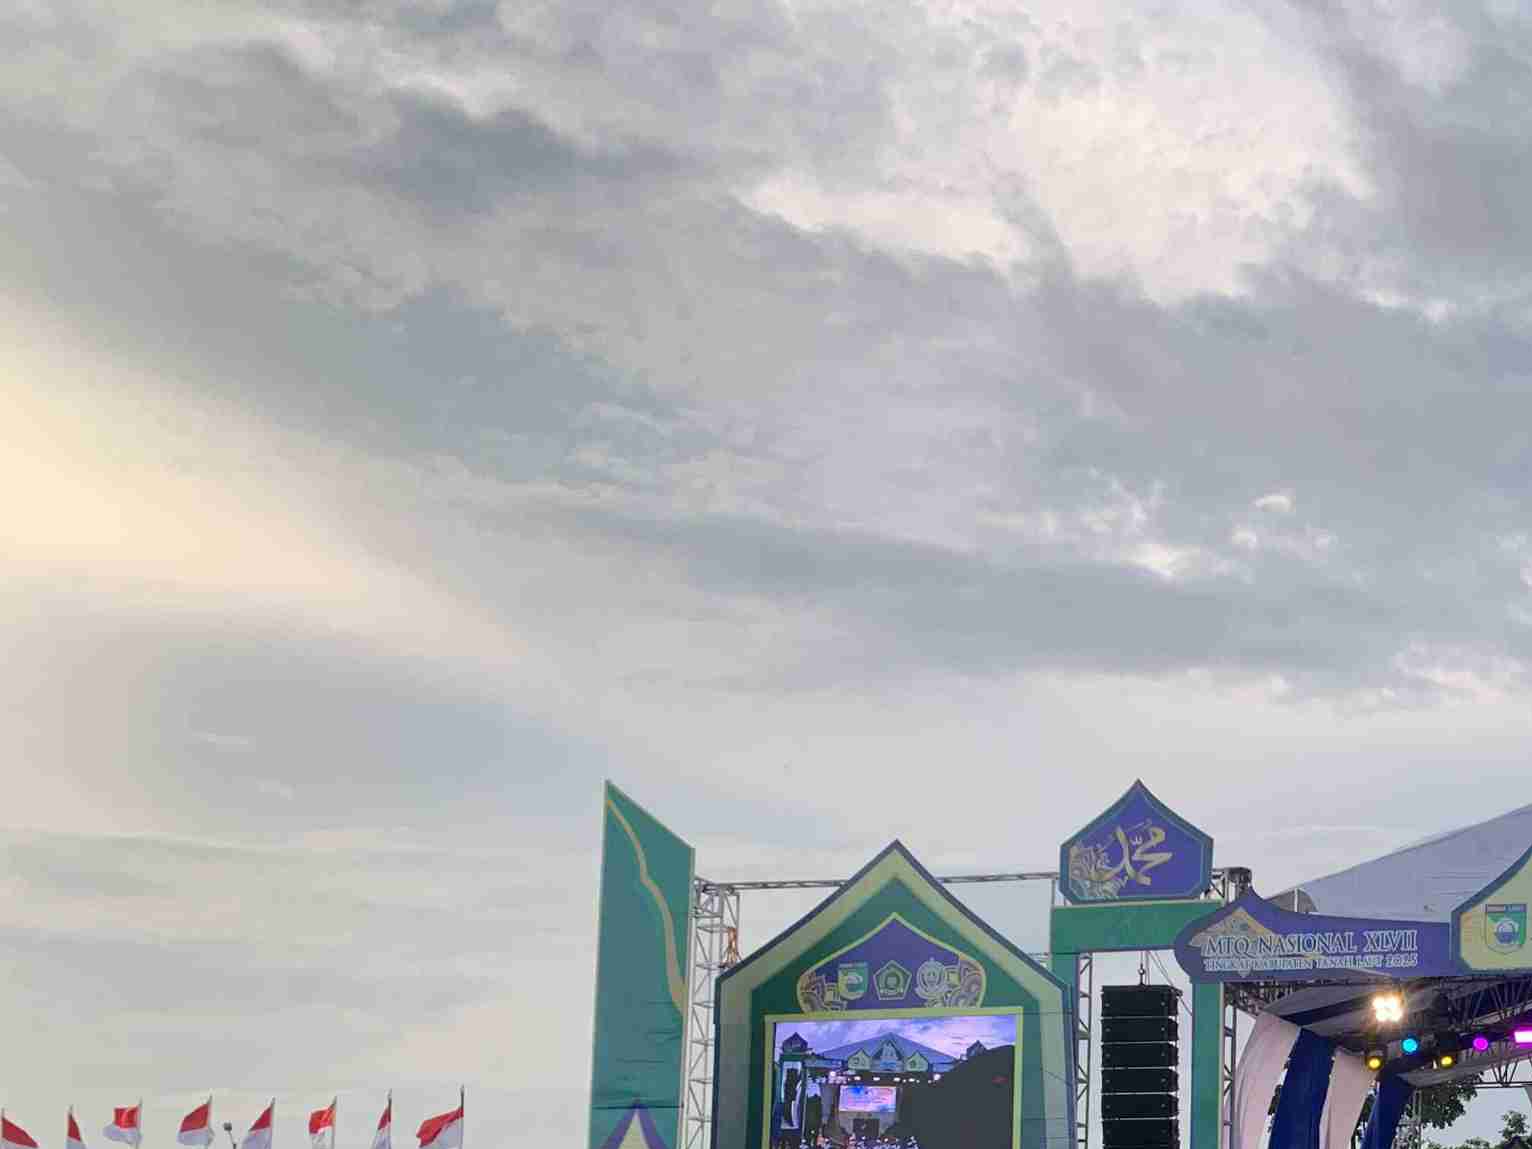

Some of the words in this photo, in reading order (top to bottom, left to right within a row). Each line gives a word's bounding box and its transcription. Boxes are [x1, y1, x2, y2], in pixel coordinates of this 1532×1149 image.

[1203, 935, 1256, 957] MTQ
[1257, 932, 1358, 956] NASIONAL
[1363, 929, 1419, 953] XLVII
